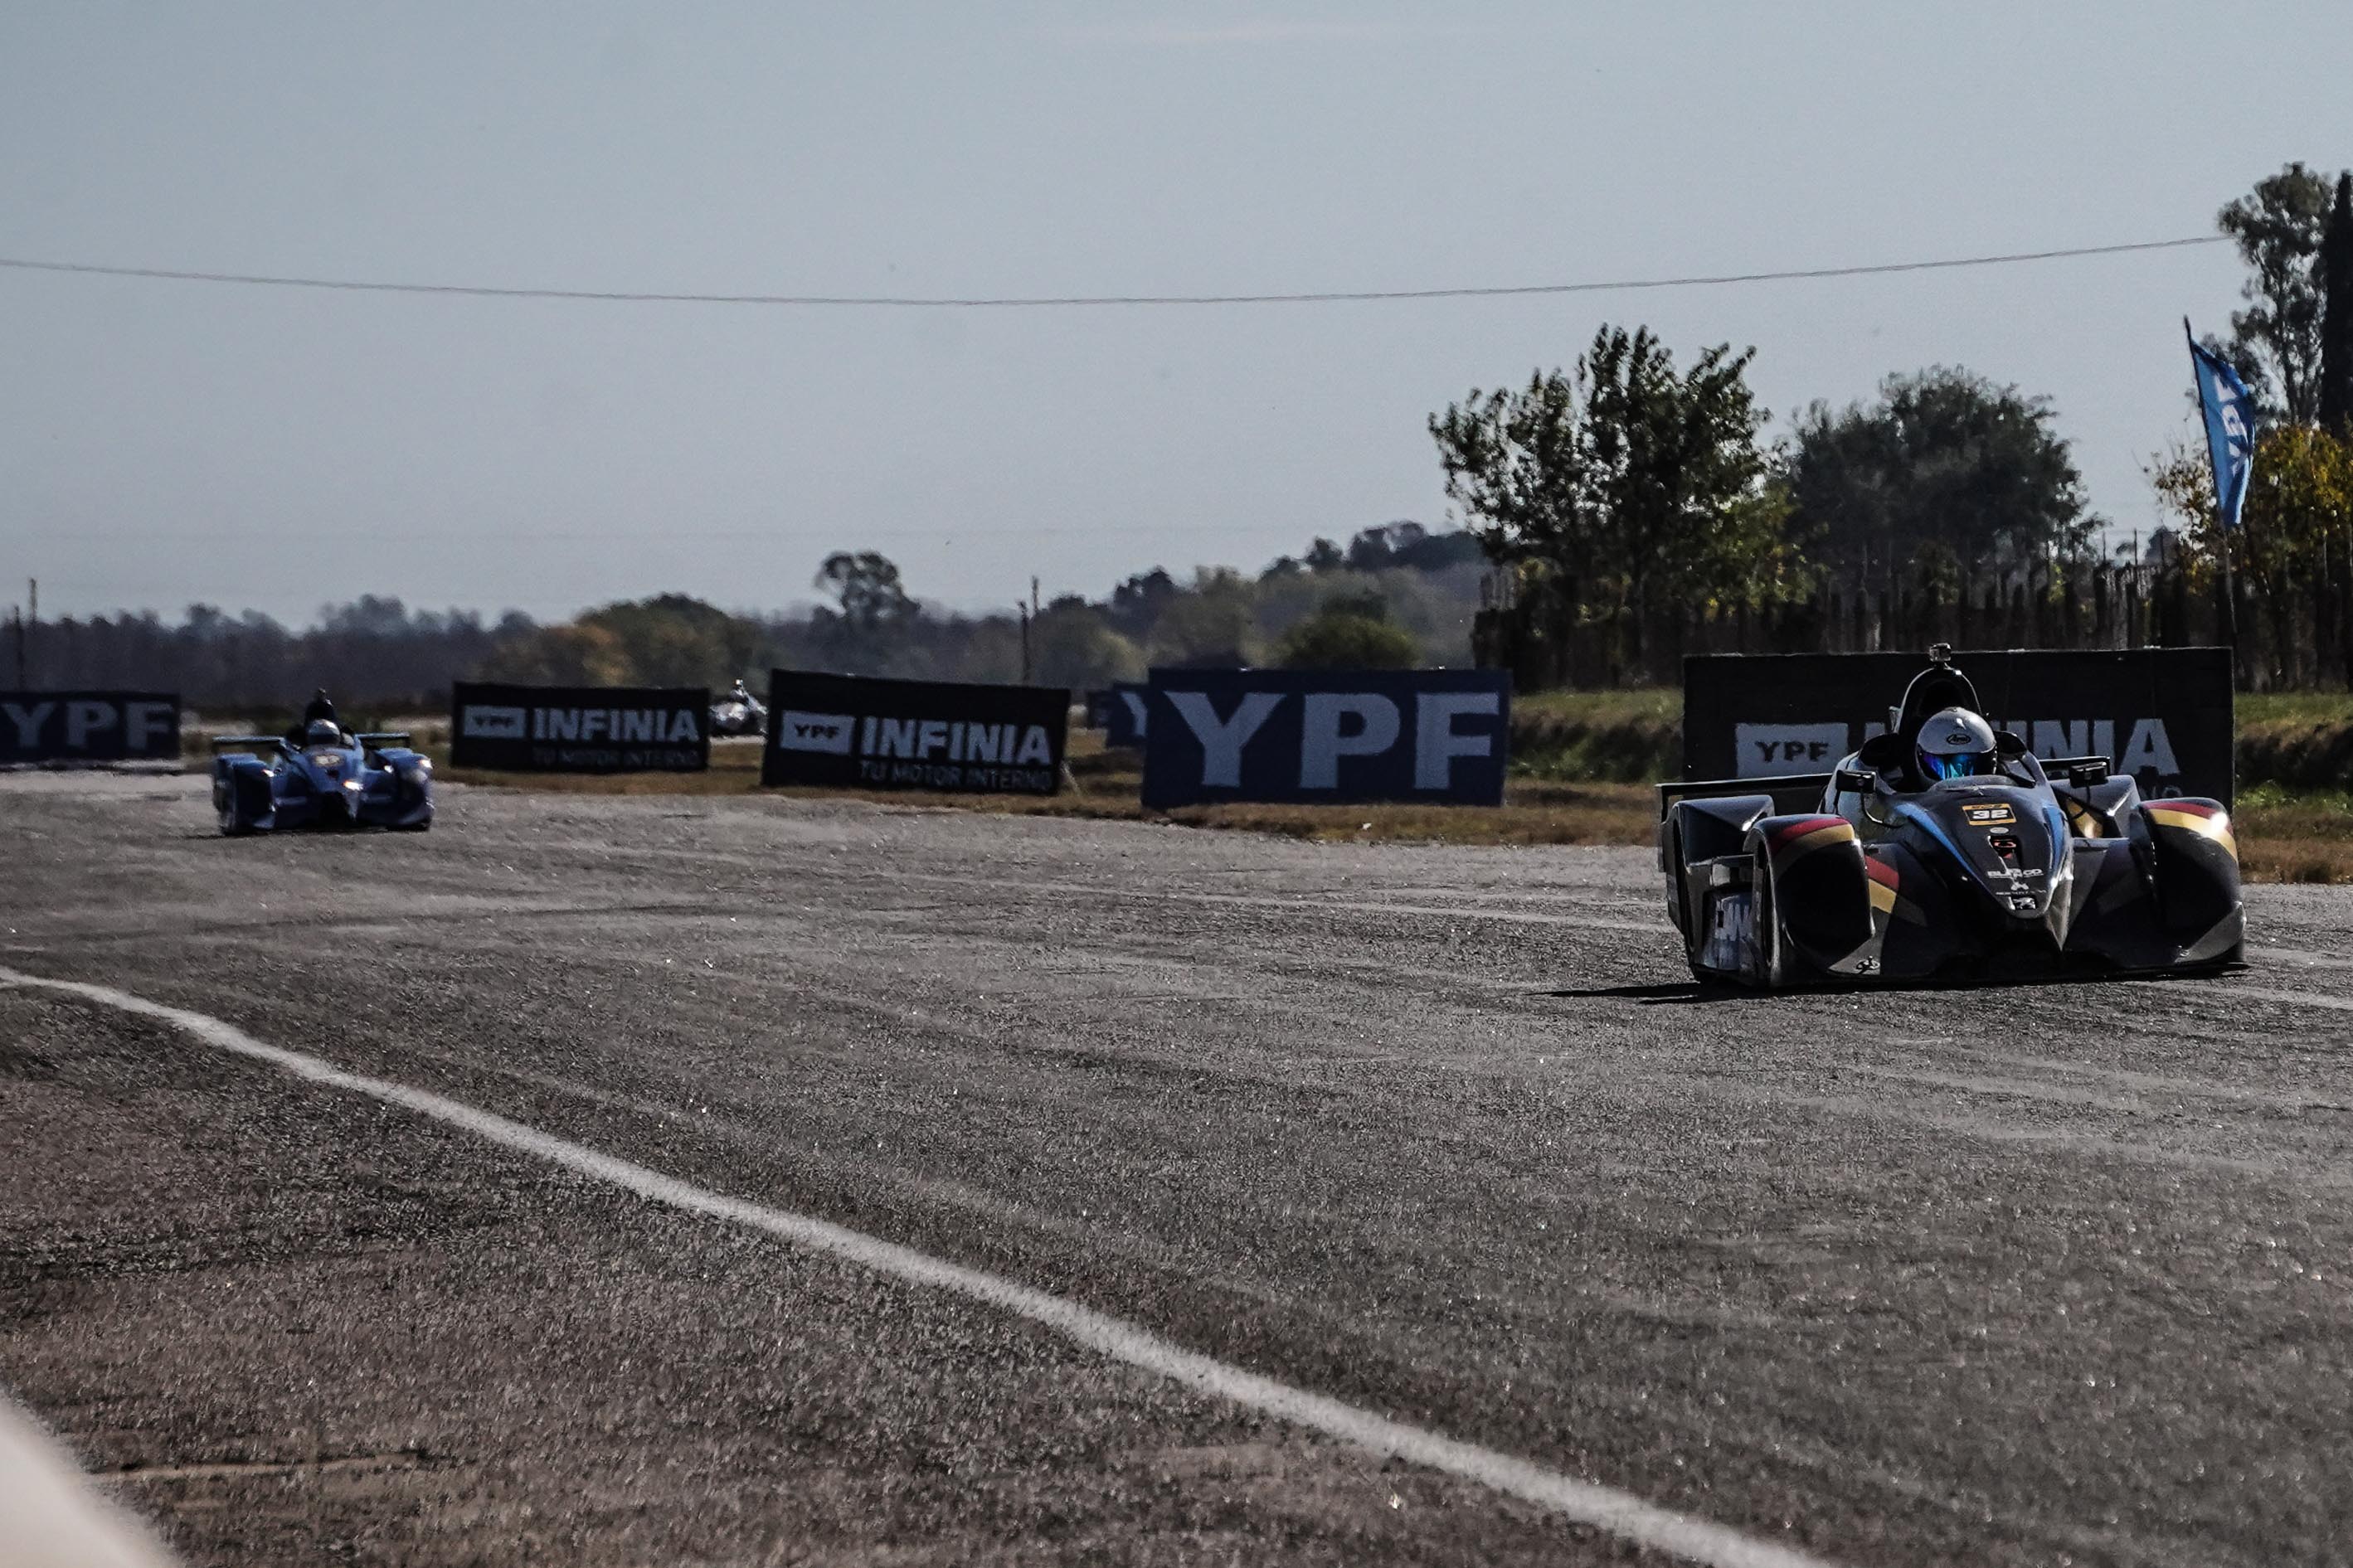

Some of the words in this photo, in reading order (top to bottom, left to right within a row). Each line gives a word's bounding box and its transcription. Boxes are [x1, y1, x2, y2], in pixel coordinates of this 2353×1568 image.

[2, 701, 173, 748] YPF
[533, 708, 699, 741] INFINIA
[794, 723, 839, 739] YPF
[860, 716, 1051, 765] INFINIA
[1164, 692, 1500, 789] YPF
[1755, 741, 1830, 761] YPF
